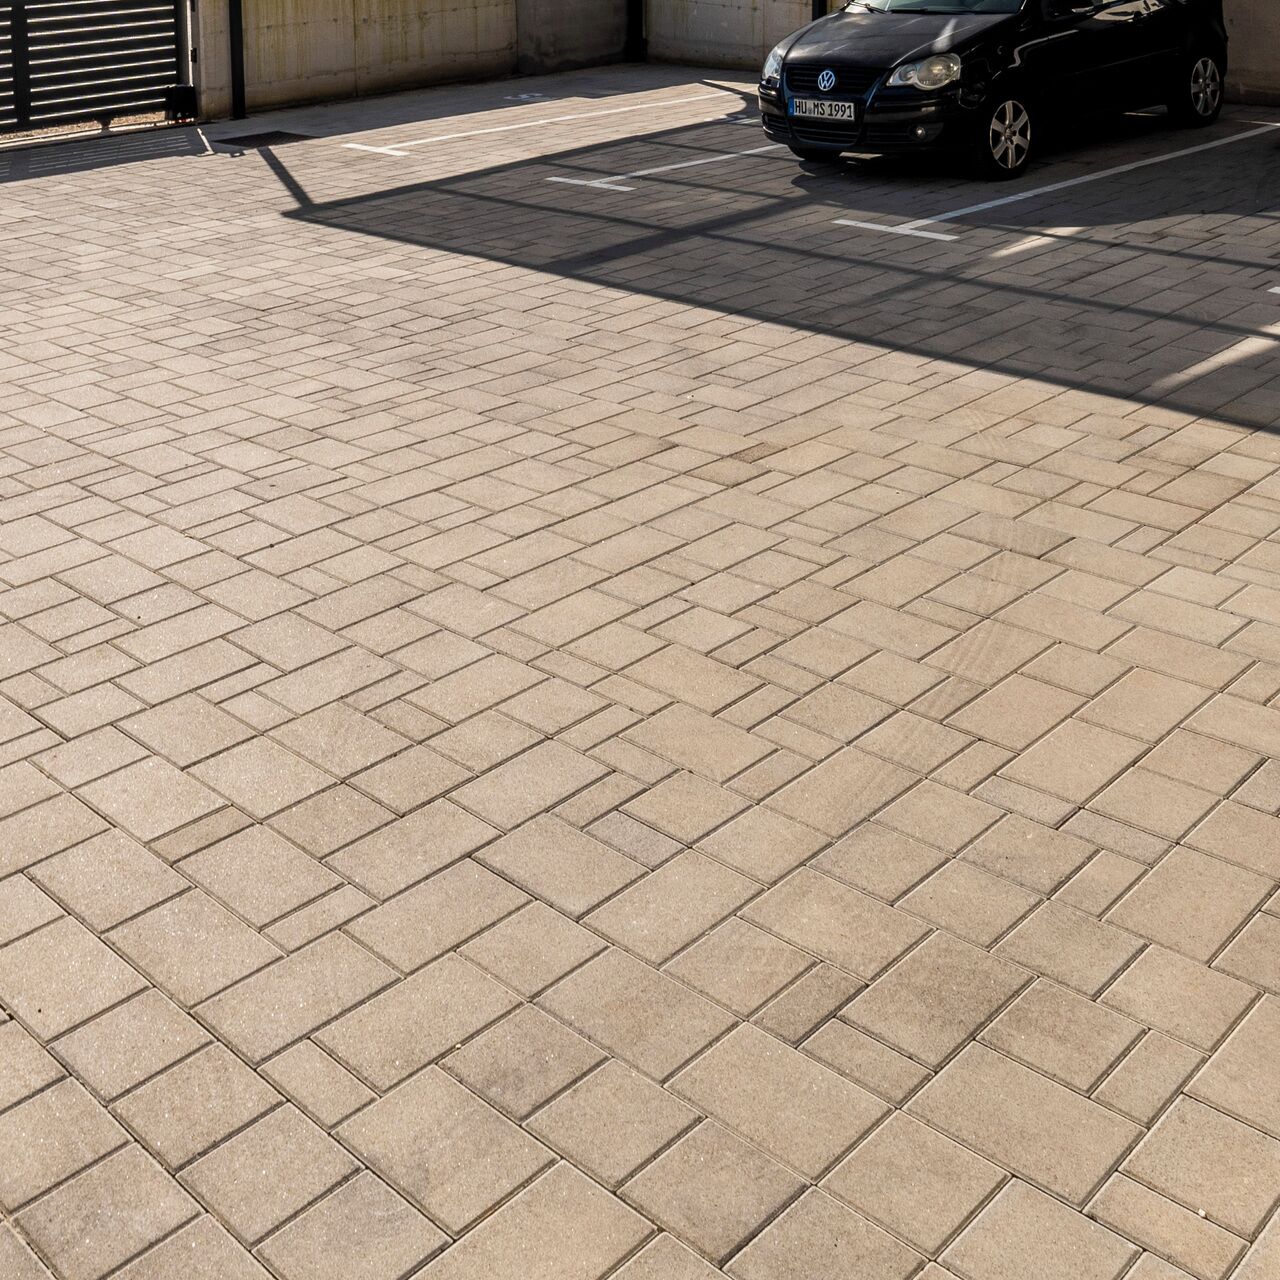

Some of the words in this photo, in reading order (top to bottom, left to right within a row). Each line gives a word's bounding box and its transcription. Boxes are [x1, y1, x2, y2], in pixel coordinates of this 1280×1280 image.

[795, 100, 807, 115] HU
[813, 102, 825, 116] MS
[827, 103, 853, 119] 1991
